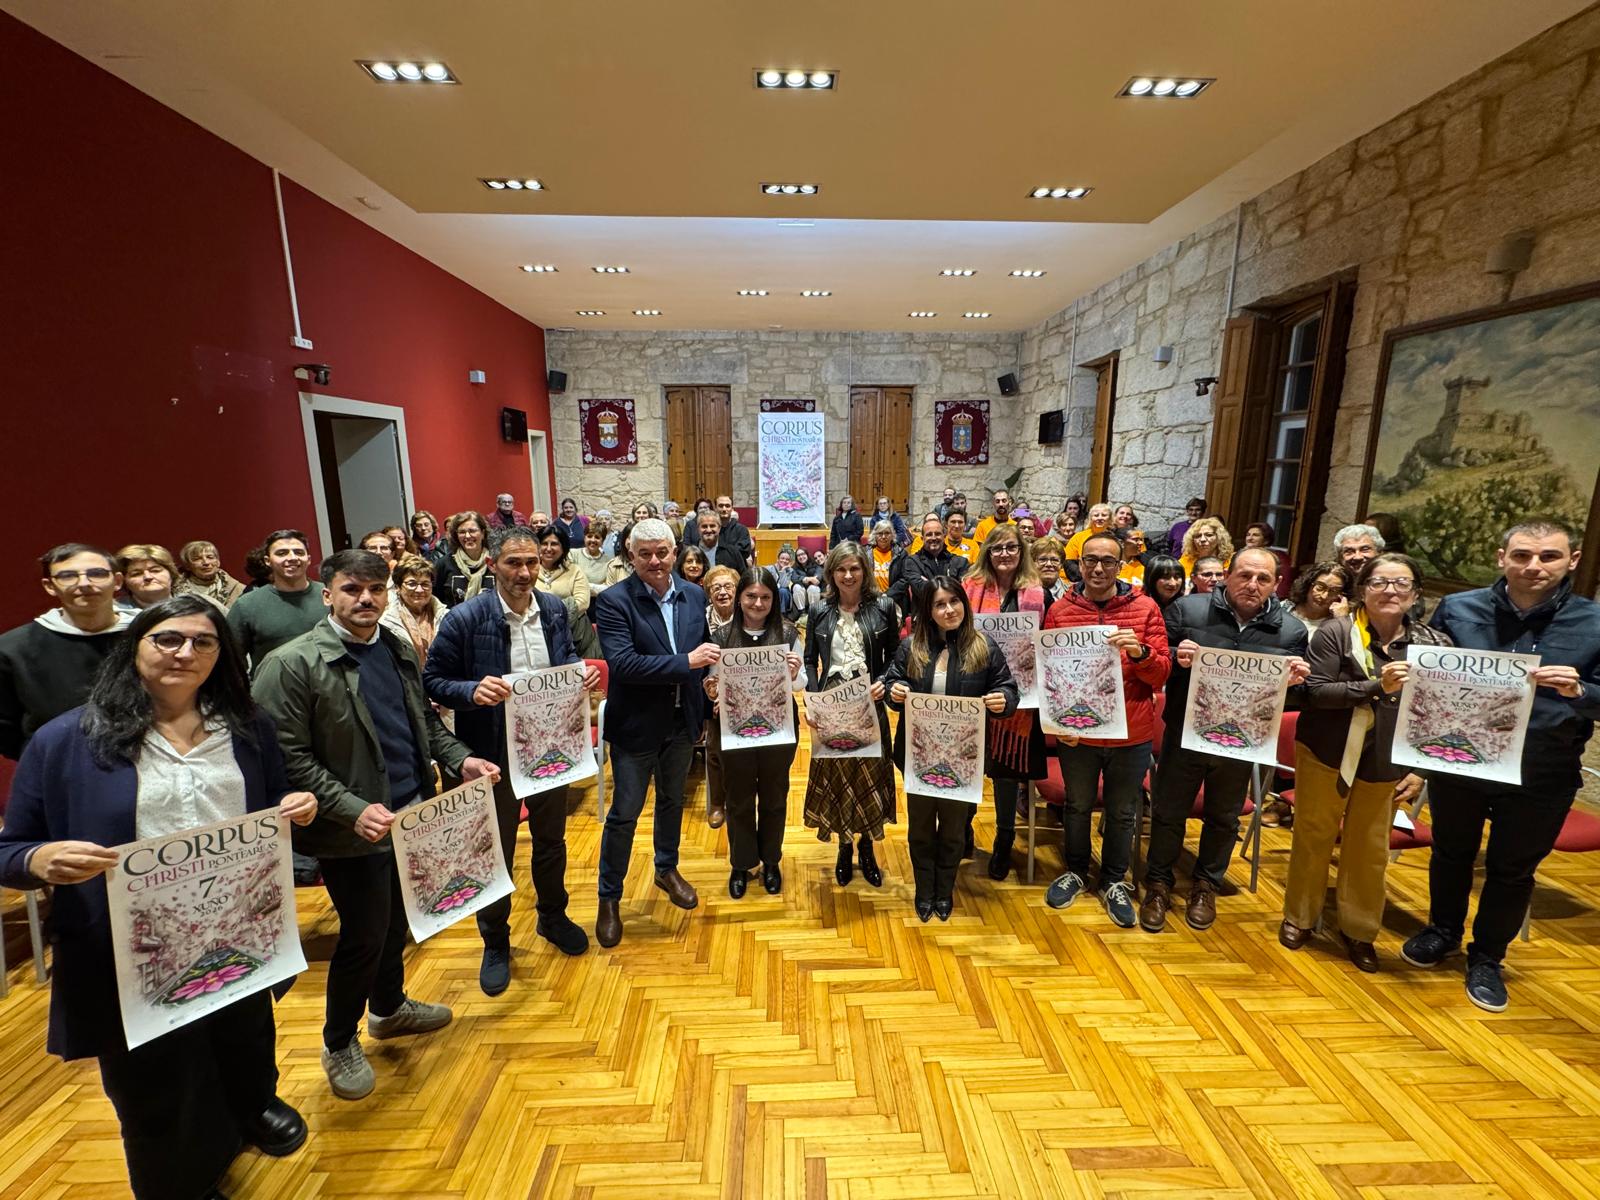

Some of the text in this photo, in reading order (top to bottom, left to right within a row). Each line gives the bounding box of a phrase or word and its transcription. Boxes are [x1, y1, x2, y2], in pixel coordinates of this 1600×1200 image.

[761, 420, 823, 437] CORPUS
[788, 450, 795, 461] 7
[1041, 630, 1110, 648] CORPUS
[722, 649, 785, 667] CORPUS
[1043, 647, 1075, 656] CHRISTI
[724, 666, 753, 675] CHRISTI
[1073, 660, 1081, 671] 7
[1201, 652, 1282, 676] CORPUS
[1418, 651, 1528, 678] CORPUS
[1200, 666, 1237, 678] CHRISTI
[1416, 669, 1467, 682] CHRISTI
[512, 668, 584, 695] CORPUS
[751, 676, 758, 687] 7
[1231, 682, 1242, 694] 7
[514, 690, 549, 705] CHRISTI
[810, 680, 867, 705] CORPUS
[1459, 687, 1473, 700] 7
[546, 703, 555, 717] 7
[911, 697, 980, 715] CORPUS
[839, 711, 846, 719] 7
[912, 709, 944, 719] CHRISTI
[940, 723, 949, 734] 7
[400, 783, 486, 831] CORPUS
[403, 817, 445, 842] CHRISTI
[443, 827, 453, 844] 7
[123, 815, 279, 876] CORPUS
[127, 858, 205, 893] CHRISTI
[208, 841, 279, 869] PONTEAREAS
[199, 875, 218, 899] 7
[200, 905, 224, 918] 2026
